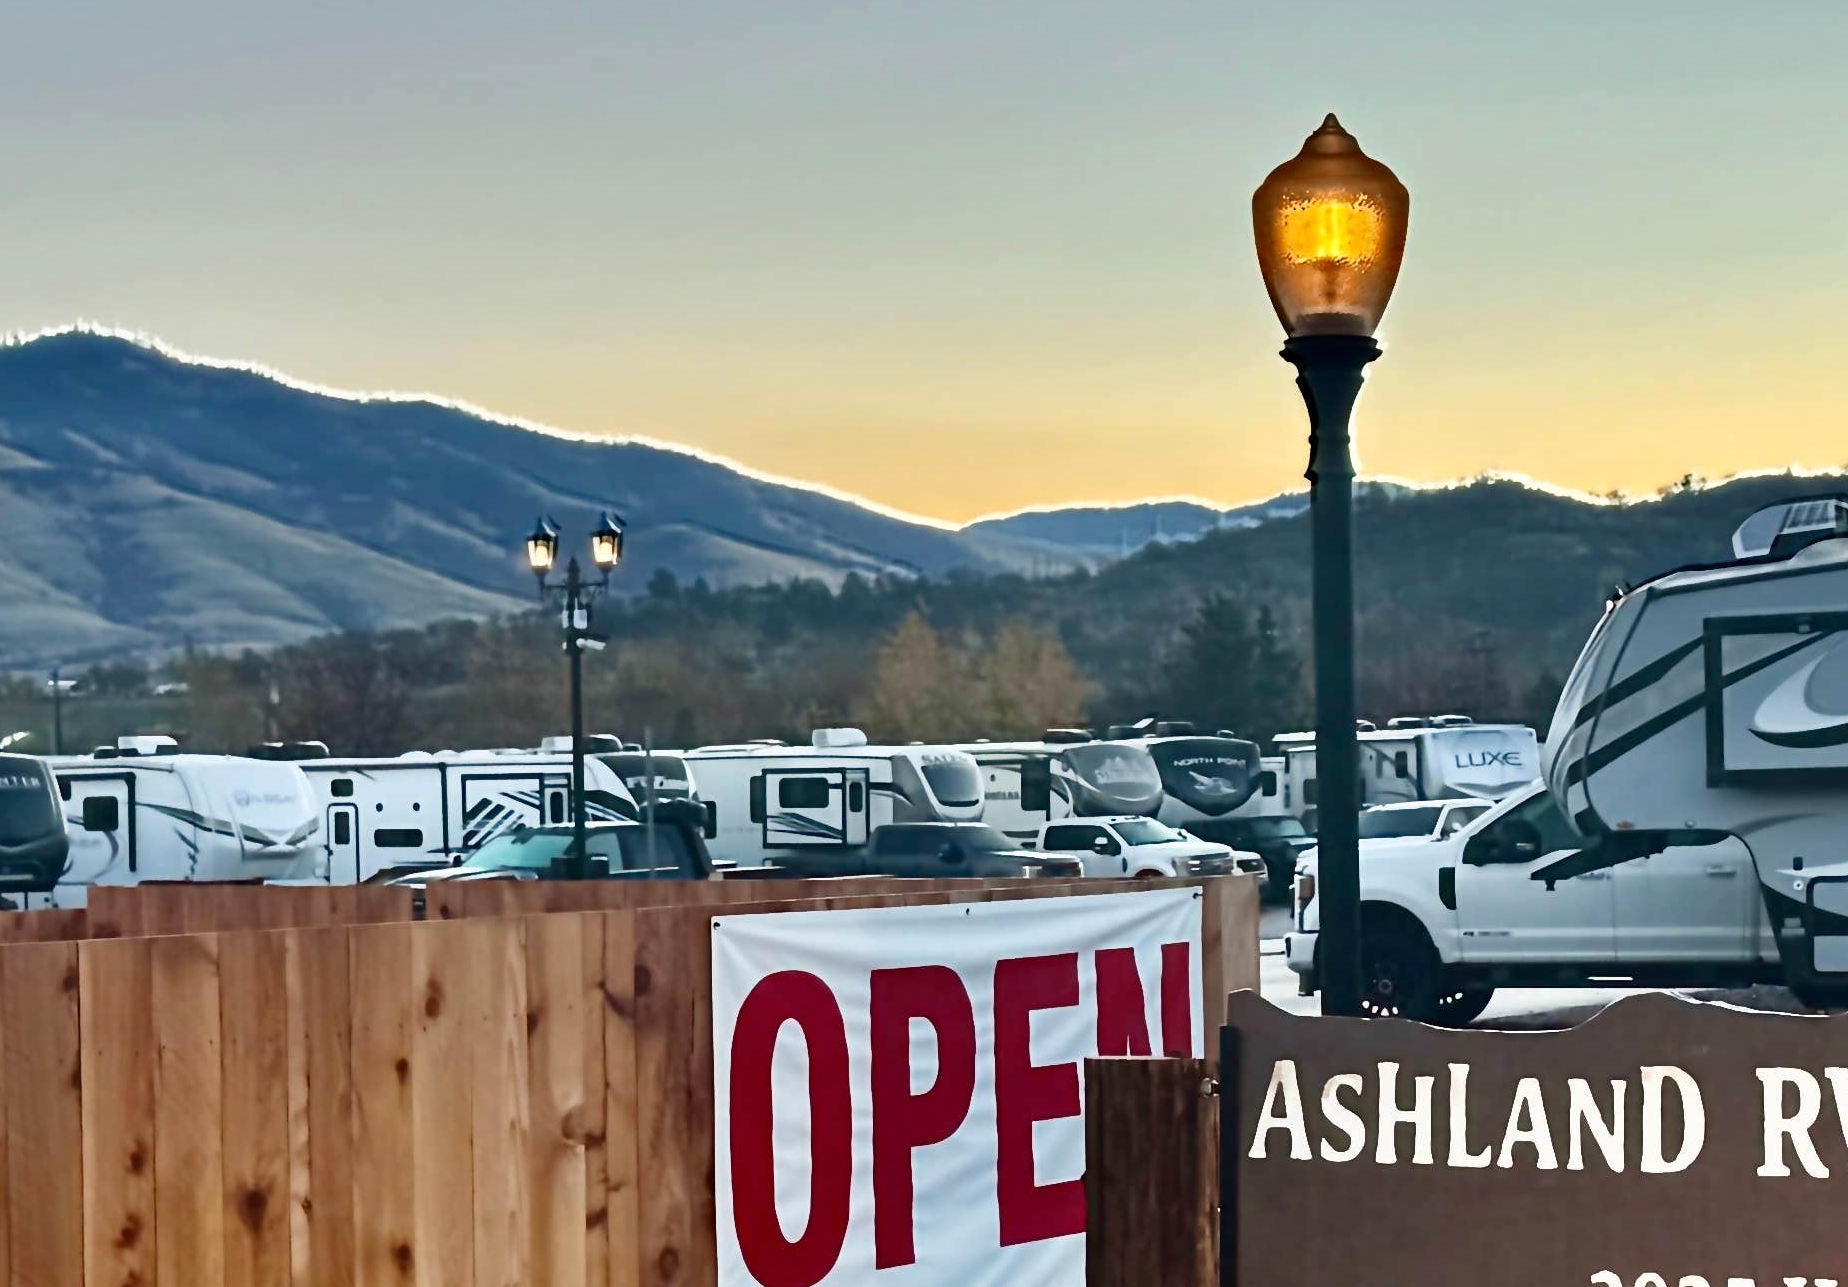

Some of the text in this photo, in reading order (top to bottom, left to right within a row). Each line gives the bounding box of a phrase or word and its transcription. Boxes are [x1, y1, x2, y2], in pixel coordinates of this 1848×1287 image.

[1173, 757, 1214, 767] NORTH
[1454, 751, 1523, 769] LUXE
[1248, 1059, 1707, 1175] ASHLAND
